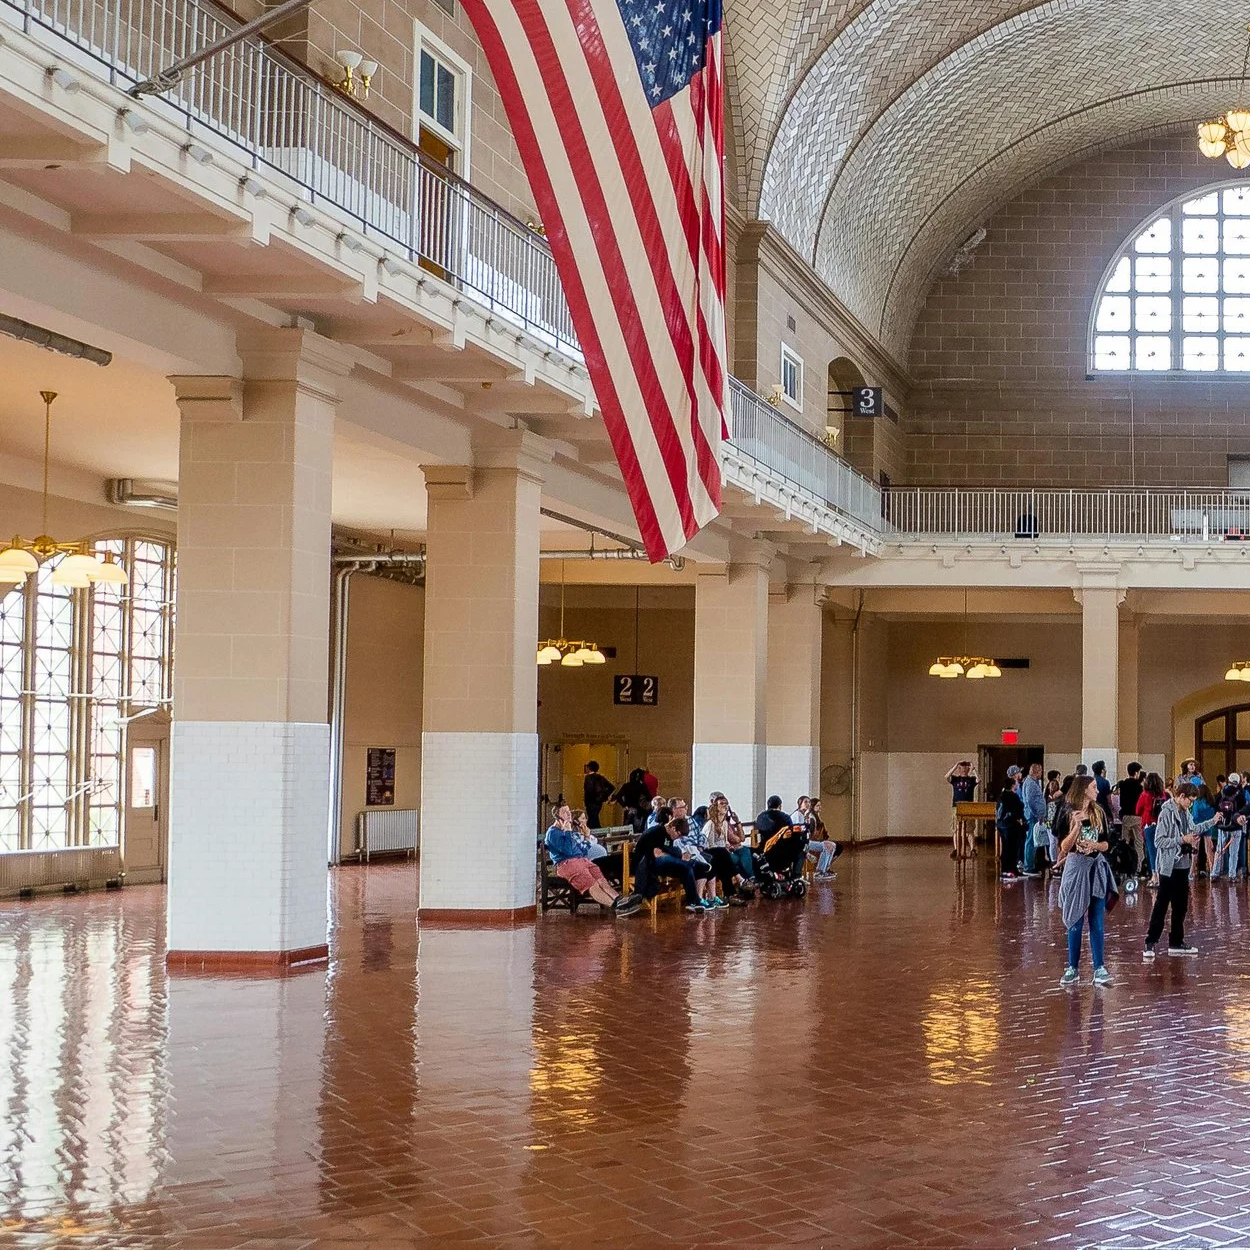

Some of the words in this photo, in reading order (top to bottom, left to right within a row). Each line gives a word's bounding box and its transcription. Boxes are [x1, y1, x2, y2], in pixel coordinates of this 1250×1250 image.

[860, 388, 875, 408] 3
[620, 677, 632, 696] 2
[643, 677, 654, 696] 2
